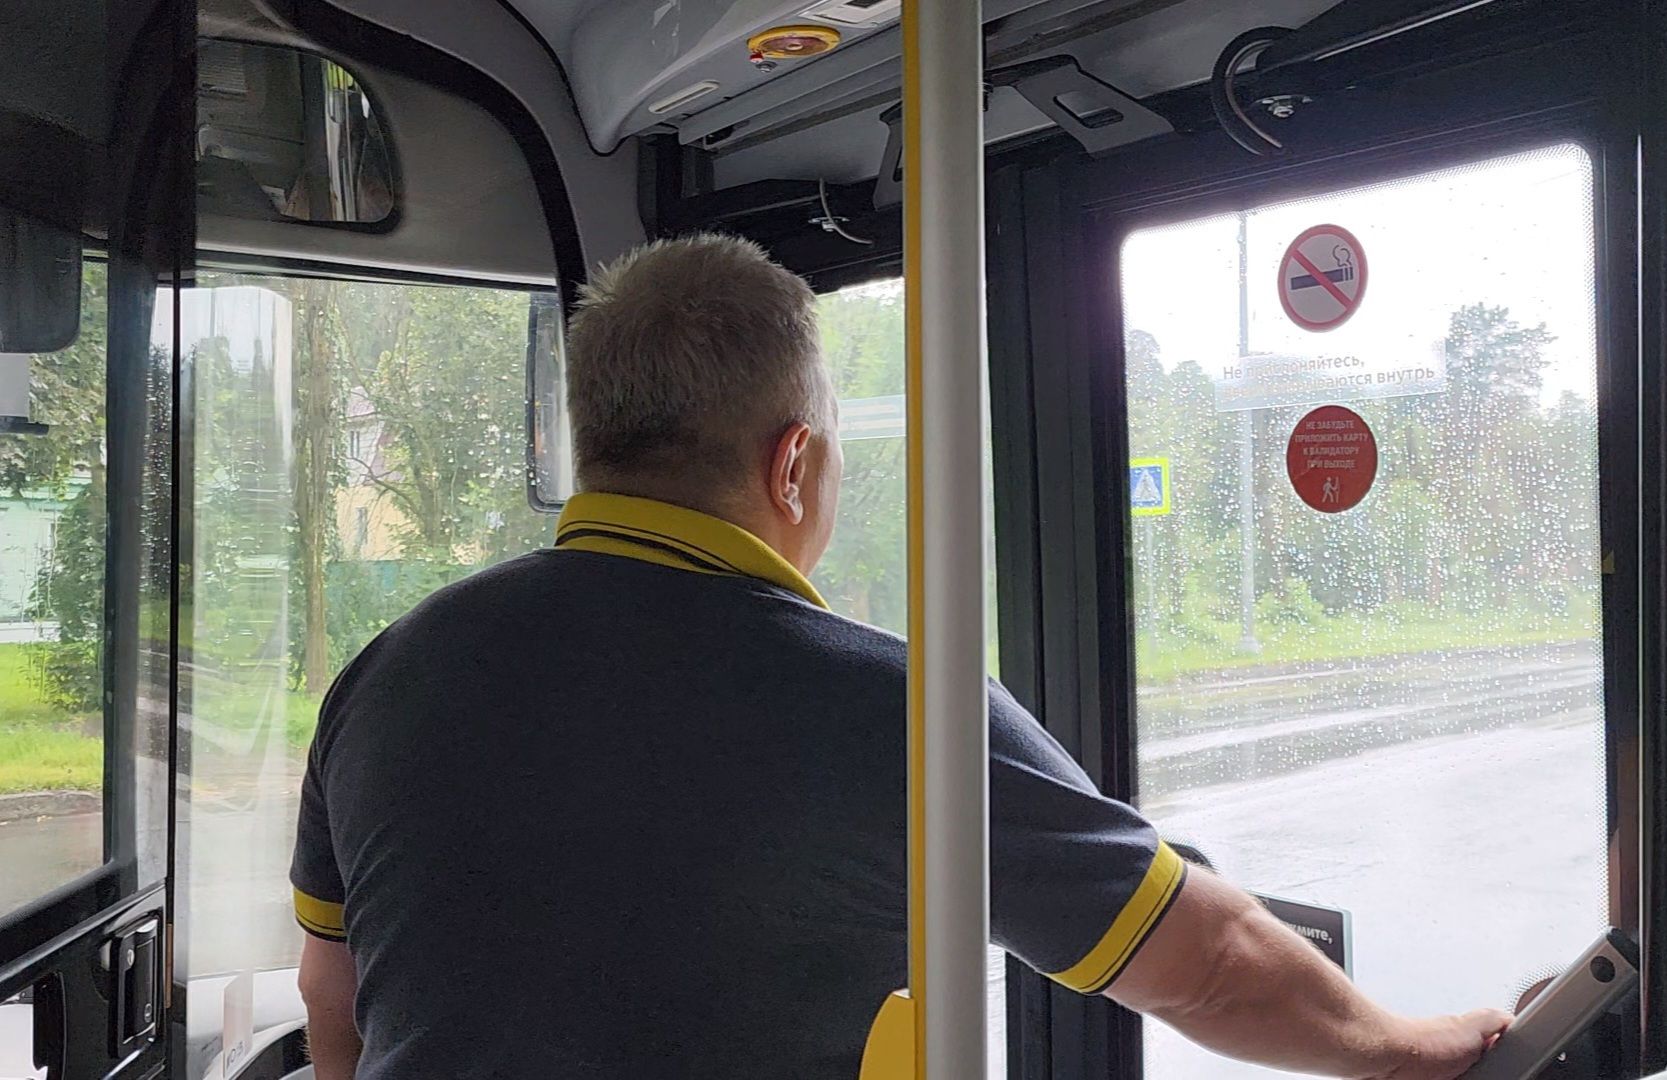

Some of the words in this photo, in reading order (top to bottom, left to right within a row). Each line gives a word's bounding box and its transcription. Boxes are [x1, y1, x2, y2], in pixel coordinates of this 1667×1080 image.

[1223, 366, 1243, 379] Не
[1376, 368, 1435, 385] внутрь
[1343, 432, 1369, 442] КАРТУ
[1309, 446, 1360, 456] ВАЛИДАТОРУ
